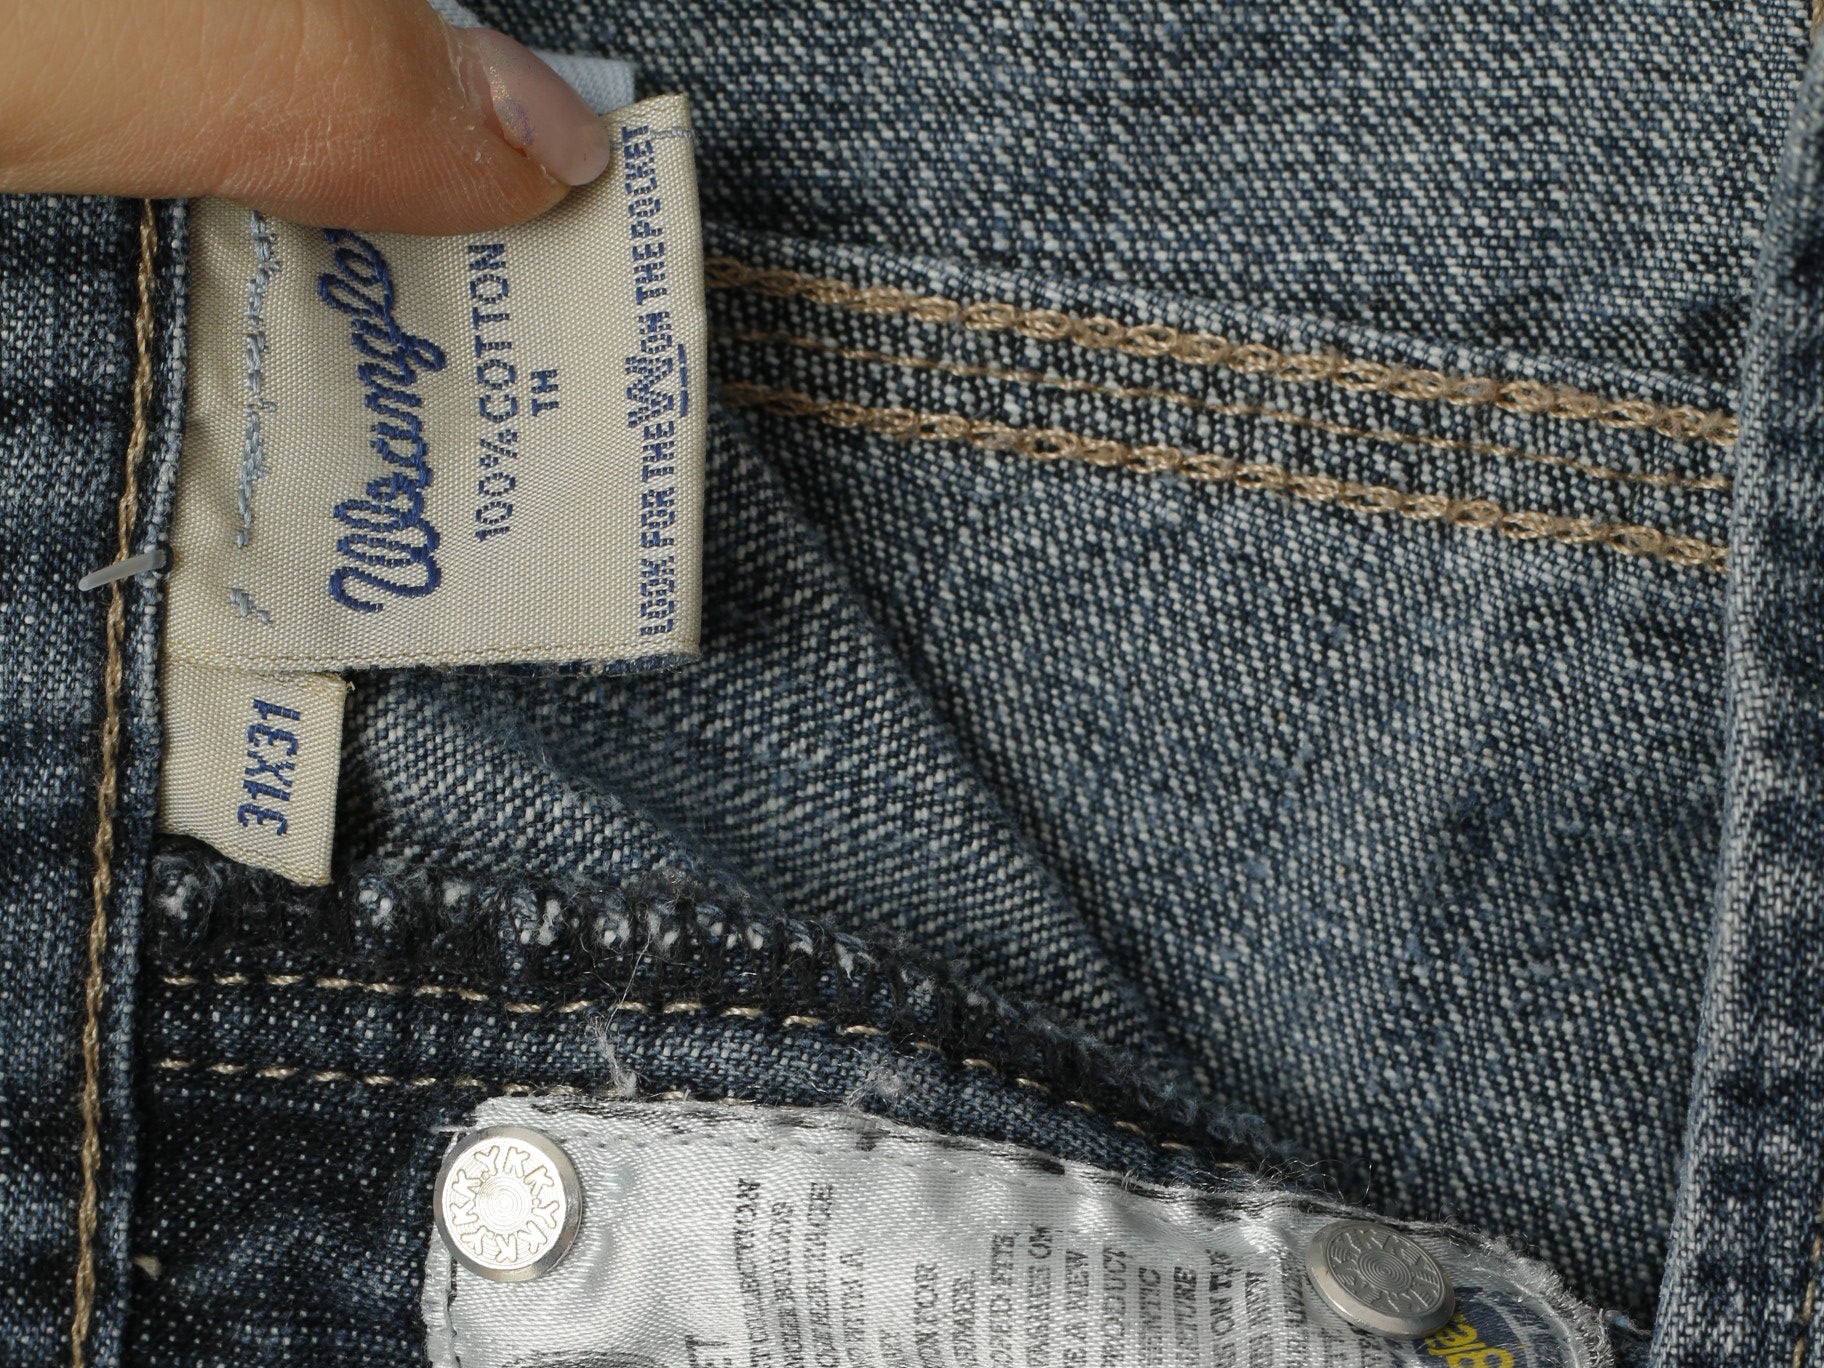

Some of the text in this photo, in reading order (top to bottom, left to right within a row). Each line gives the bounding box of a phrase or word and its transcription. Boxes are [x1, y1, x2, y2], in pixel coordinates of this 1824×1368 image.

[621, 124, 665, 238] POCKET
[632, 241, 669, 303] THE
[531, 367, 561, 417] TH
[640, 420, 676, 482] THE
[639, 484, 676, 546] FOR
[639, 553, 675, 637] LOOK
[237, 699, 300, 836] 31X31
[733, 1178, 769, 1344] COLLECTION
[1208, 1296, 1235, 1337] ON
